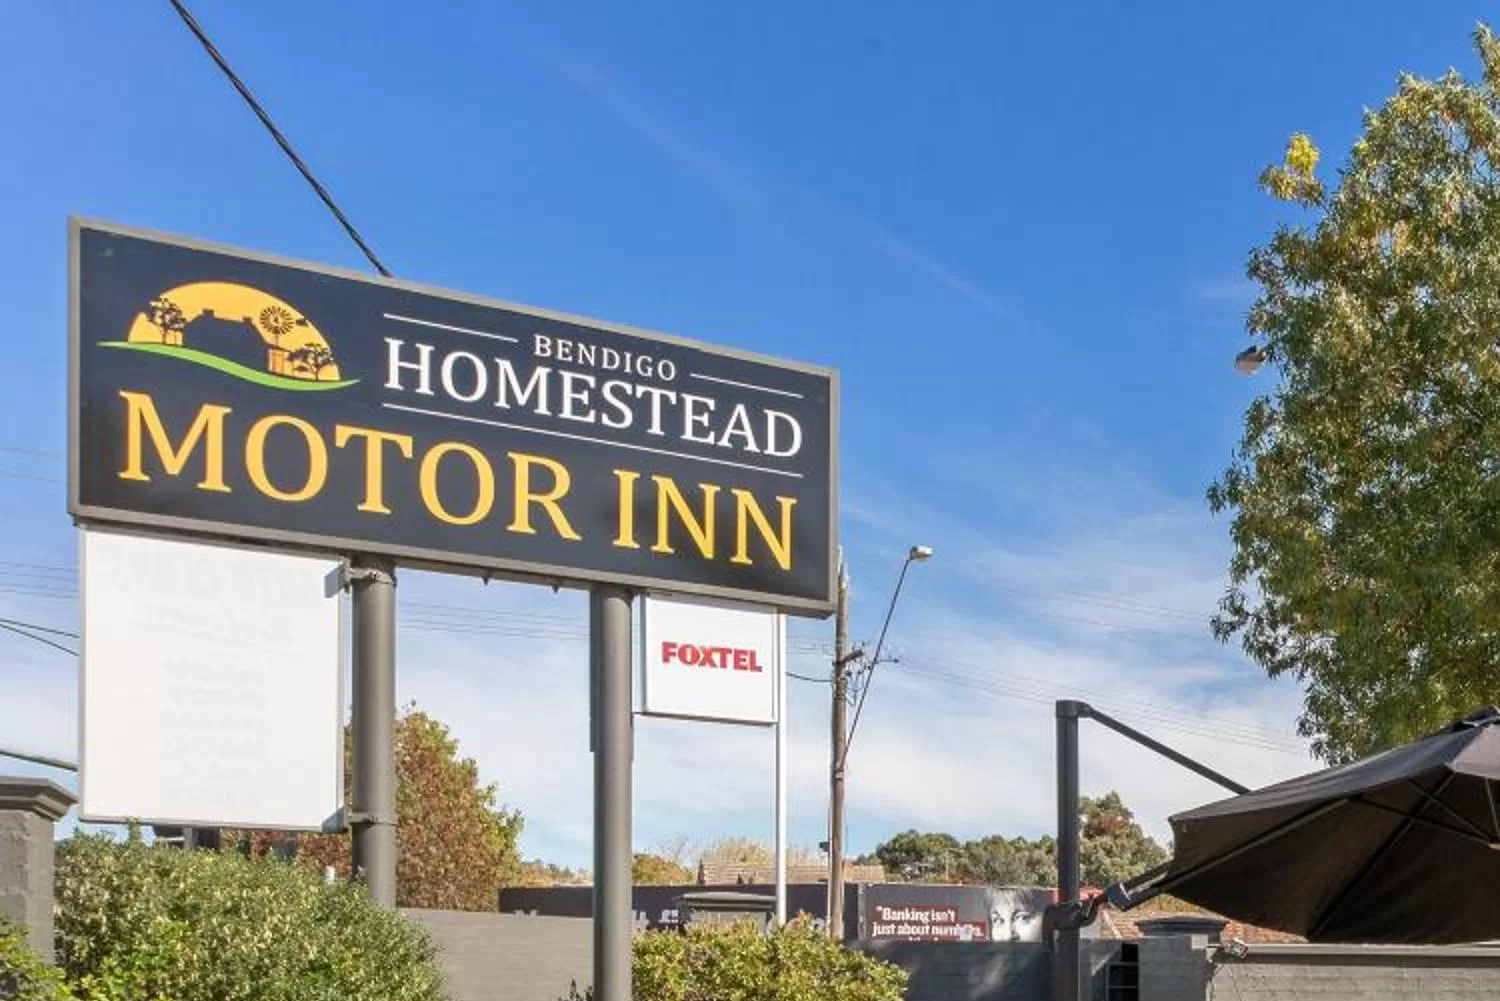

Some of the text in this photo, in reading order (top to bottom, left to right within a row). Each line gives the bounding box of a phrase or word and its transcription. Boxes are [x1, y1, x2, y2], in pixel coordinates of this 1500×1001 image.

[533, 333, 677, 382] BENDIGO
[383, 337, 803, 458] HOMESTEAD
[117, 388, 798, 573] MOTOR INN
[661, 641, 763, 672] FOXTEL
[872, 921, 896, 937] just
[897, 923, 930, 935] about
